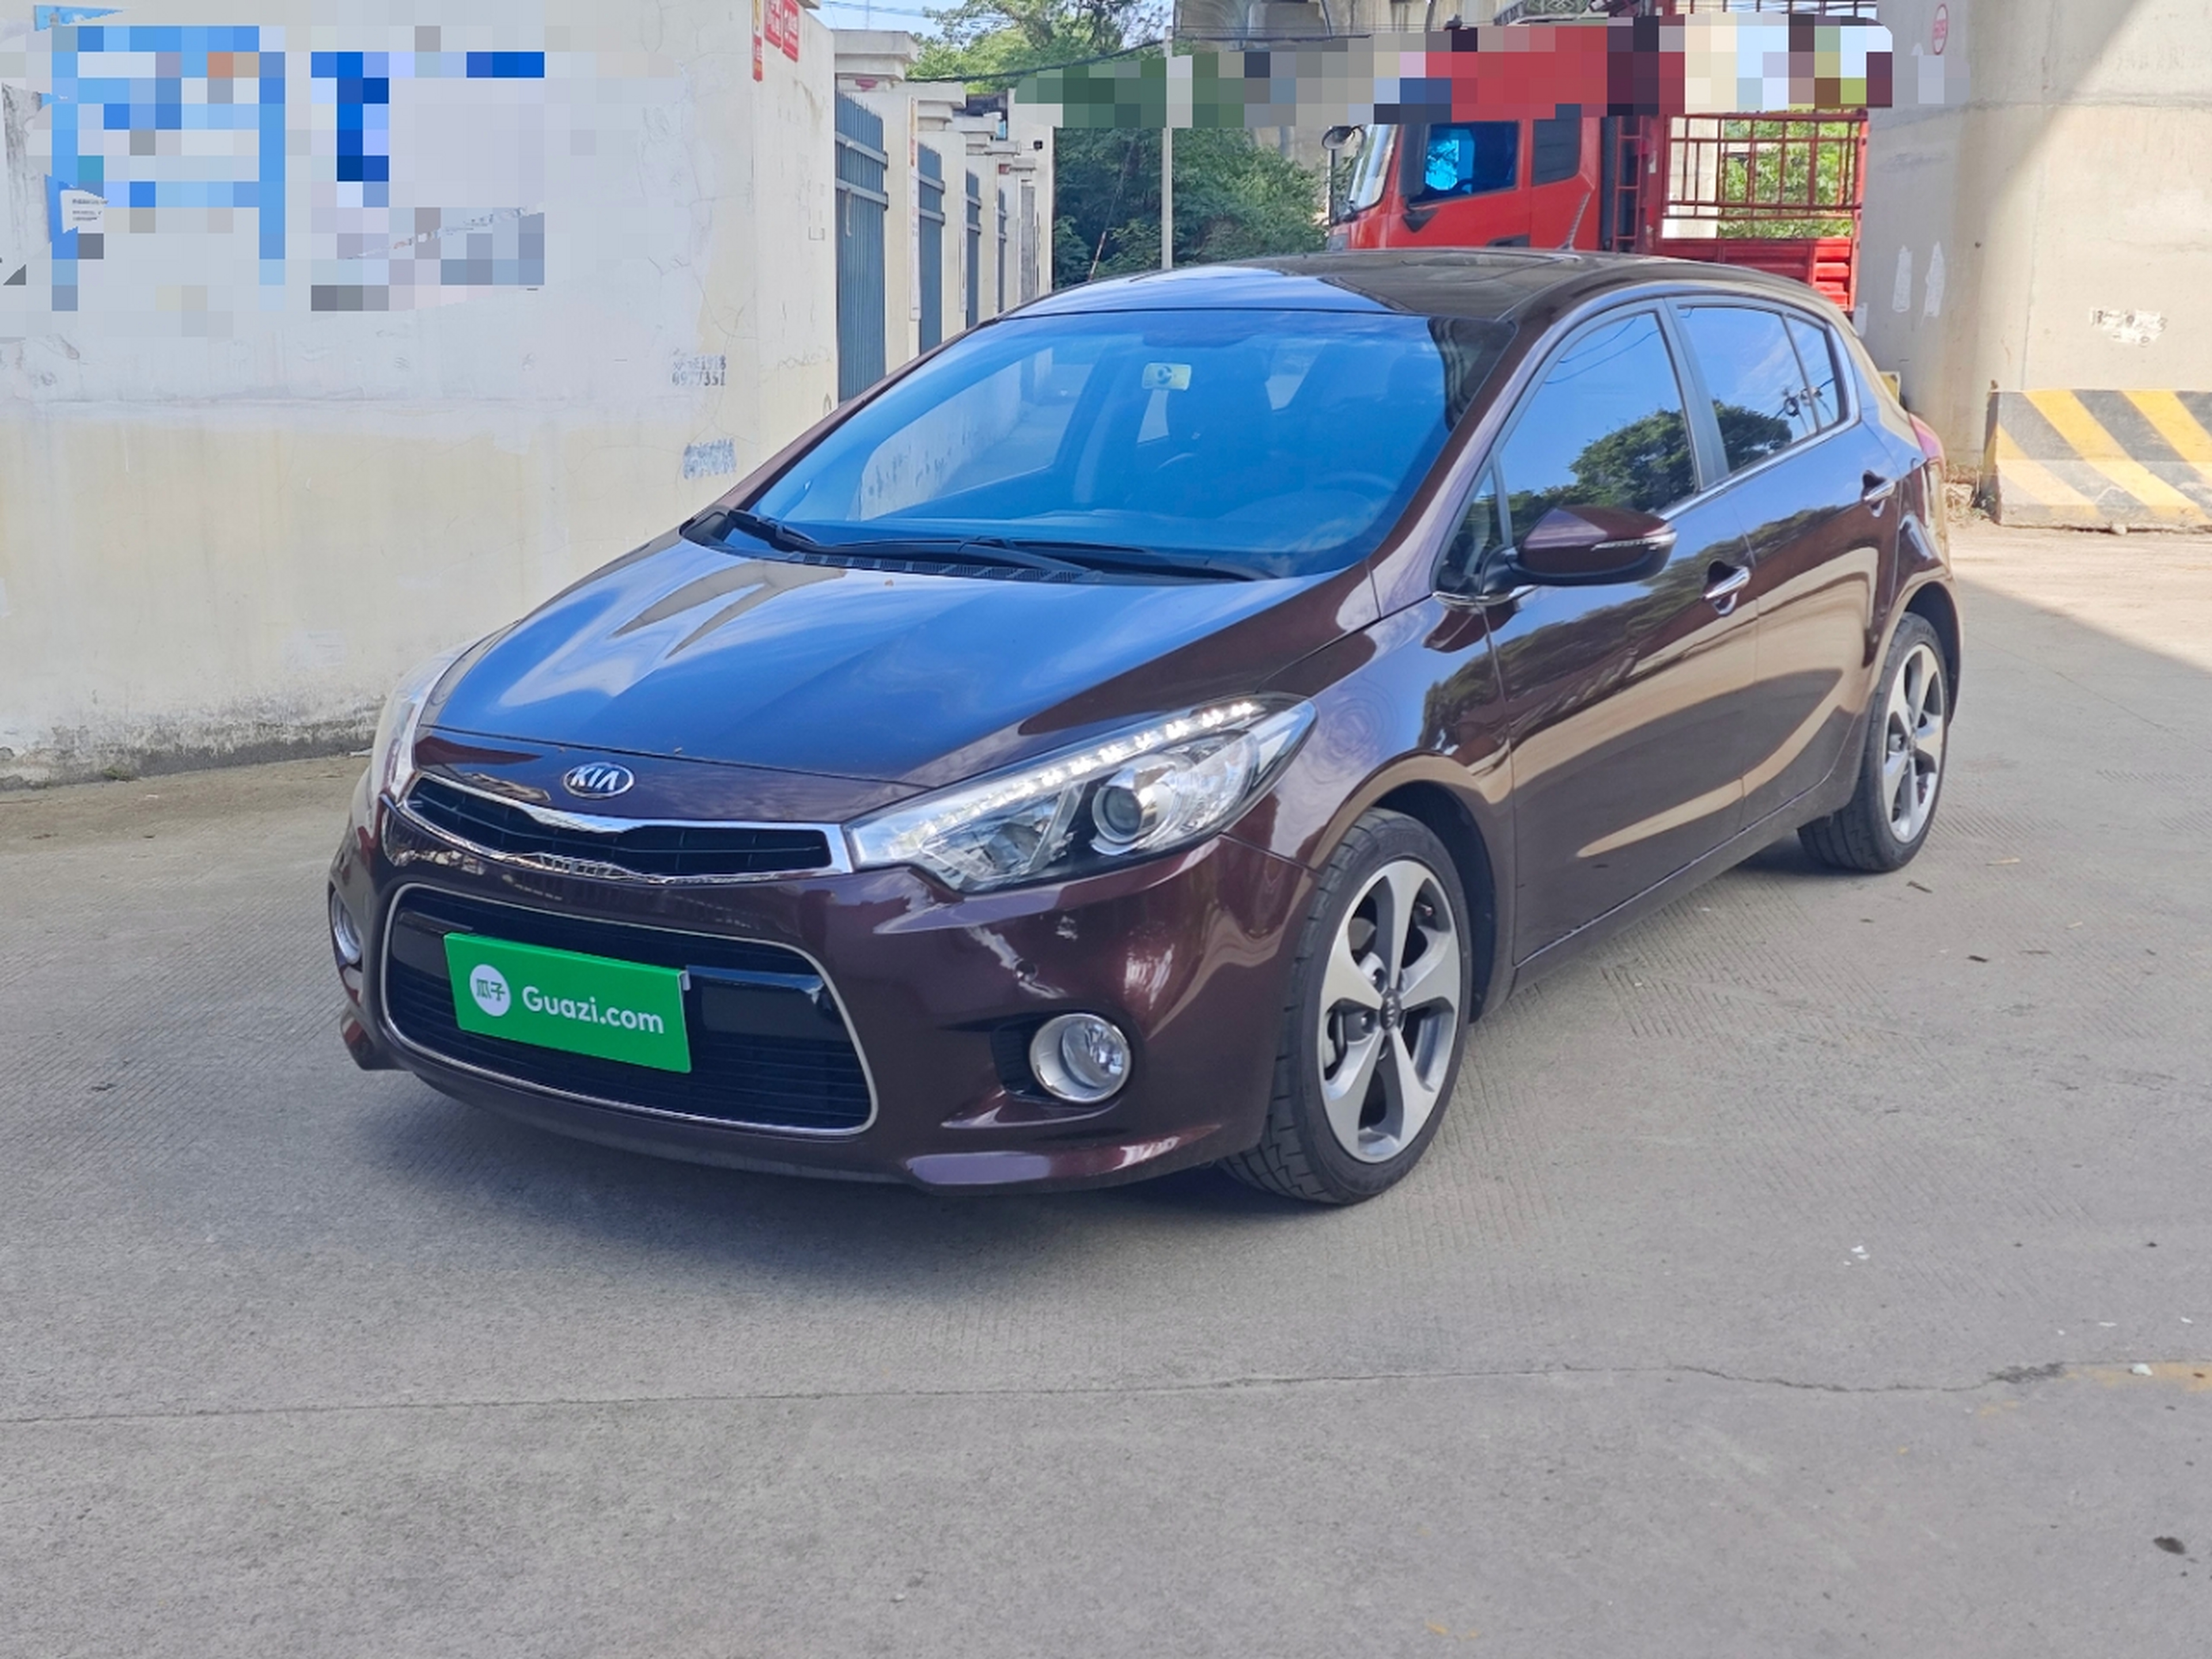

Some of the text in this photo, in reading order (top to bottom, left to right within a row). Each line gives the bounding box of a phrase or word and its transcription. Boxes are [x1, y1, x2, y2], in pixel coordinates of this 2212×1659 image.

[570, 767, 620, 791] KIA
[476, 978, 506, 1002] 瓜子
[522, 986, 664, 1035] Guazi.com
